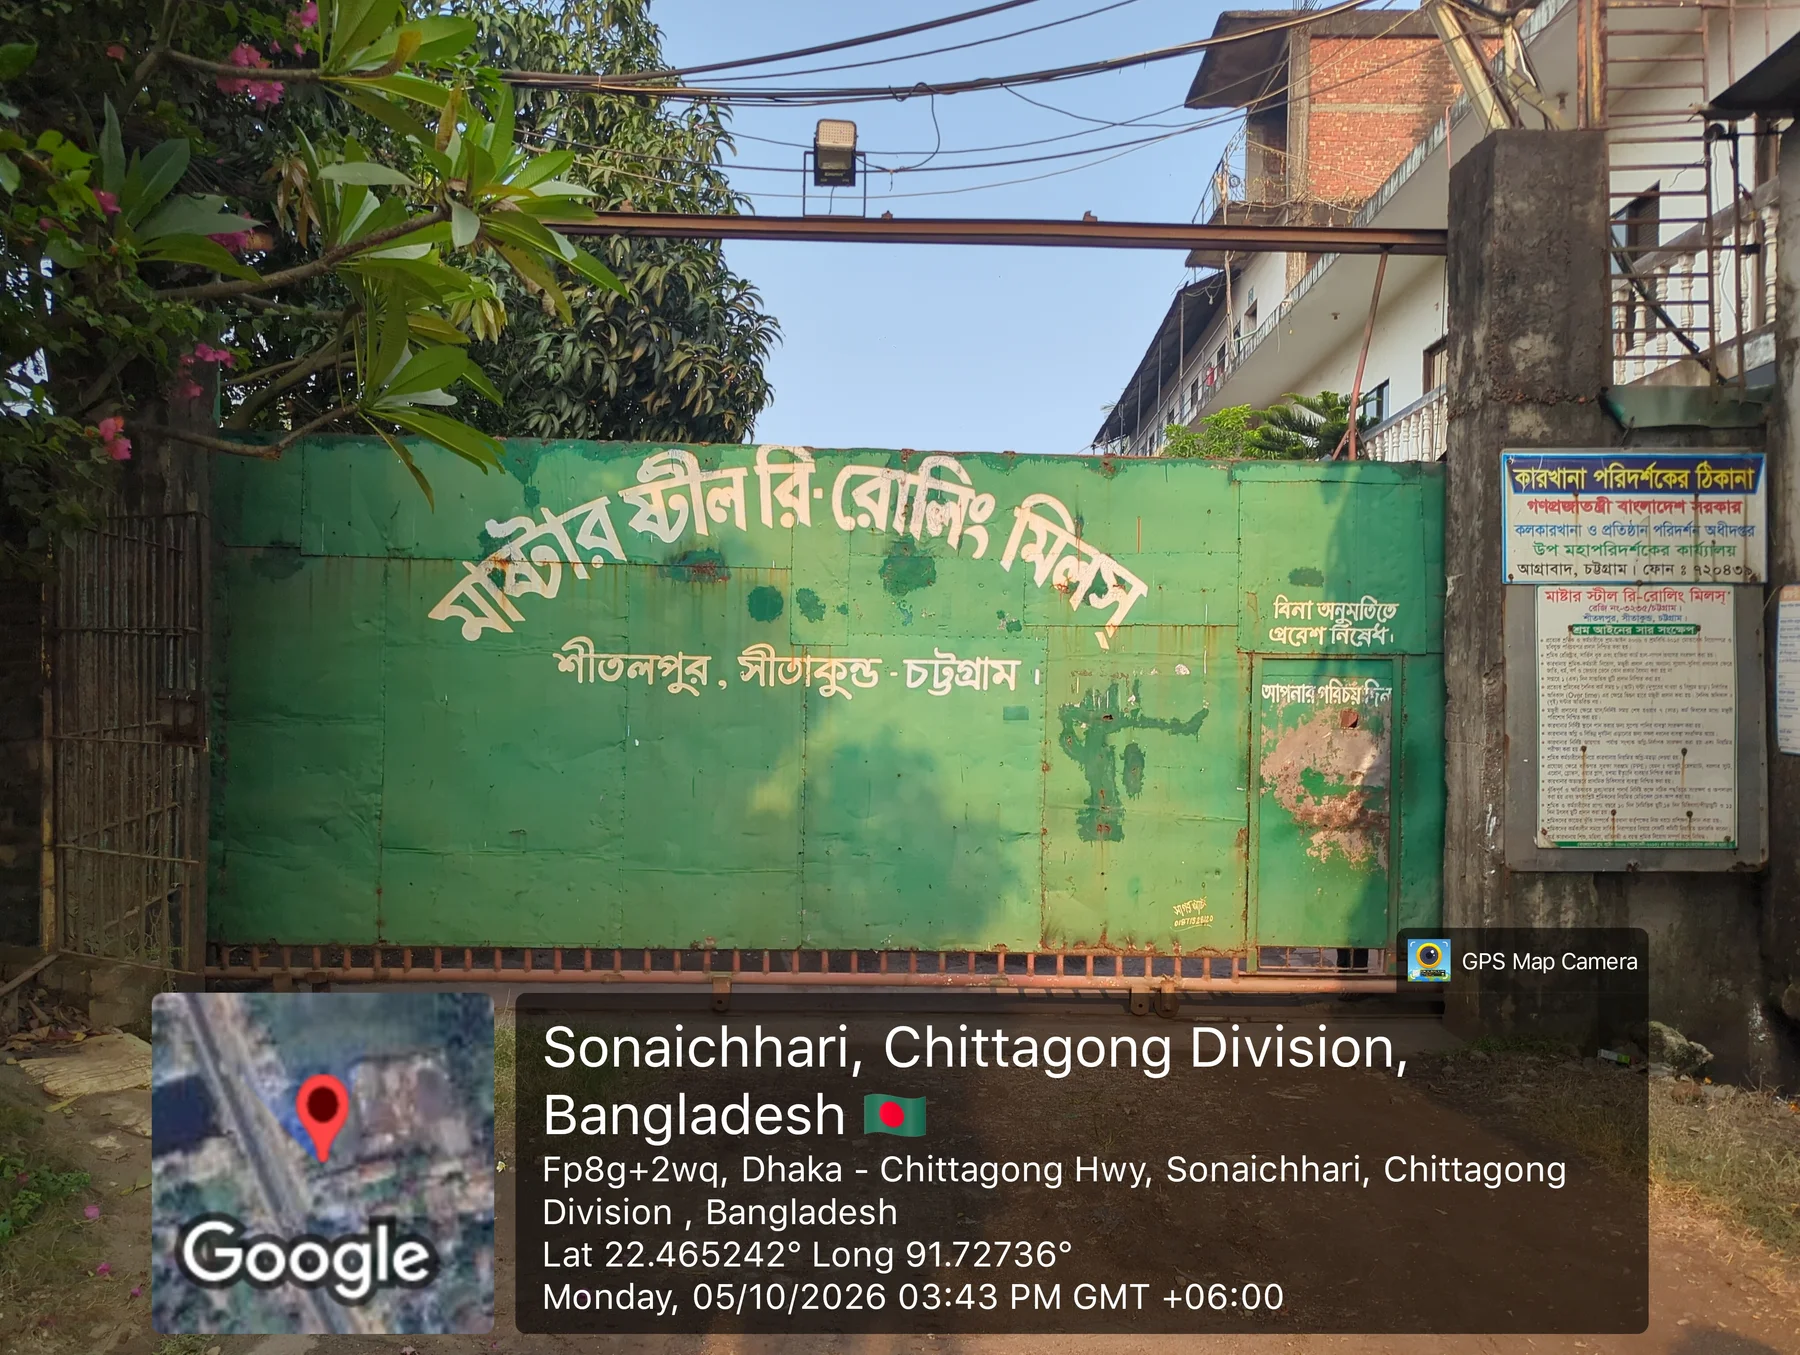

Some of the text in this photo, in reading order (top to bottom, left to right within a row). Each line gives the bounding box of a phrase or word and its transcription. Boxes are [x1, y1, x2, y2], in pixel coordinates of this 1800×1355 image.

[1513, 460, 1755, 491] কারখানা পরিদর্শকের ঠিকানা
[1527, 495, 1743, 515] গণপ্রজাতন্ত্রী বাংলাদেশ সরকার
[1514, 523, 1582, 538] কলকারখানা
[1587, 525, 1597, 537] ও
[1602, 519, 1649, 538] প্রতিষ্ঠান
[1653, 520, 1699, 538] পরিদর্শন
[1533, 541, 1559, 557] উপ
[1564, 541, 1670, 558] মহাপরিদর্শকের
[428, 497, 627, 641] মাষ্টার
[1000, 493, 1149, 650] মিলস্
[1517, 562, 1578, 578] আগ্রাবাদ,
[1584, 559, 1627, 576] চট্টগ্রাম
[1643, 562, 1674, 576] ফোন
[1545, 586, 1582, 603] মাষ্টার
[1623, 586, 1686, 604] রি-রোলিং
[1689, 586, 1727, 605] মিলস্
[1273, 594, 1400, 625] বিনা অনুমতিতে
[1269, 625, 1327, 647] প্রবেশ
[1573, 624, 1696, 635] শ্রম আইনের সার সংক্ষেপ
[902, 647, 1022, 696] চট্টগ্রাম
[1262, 682, 1316, 704] আপনার
